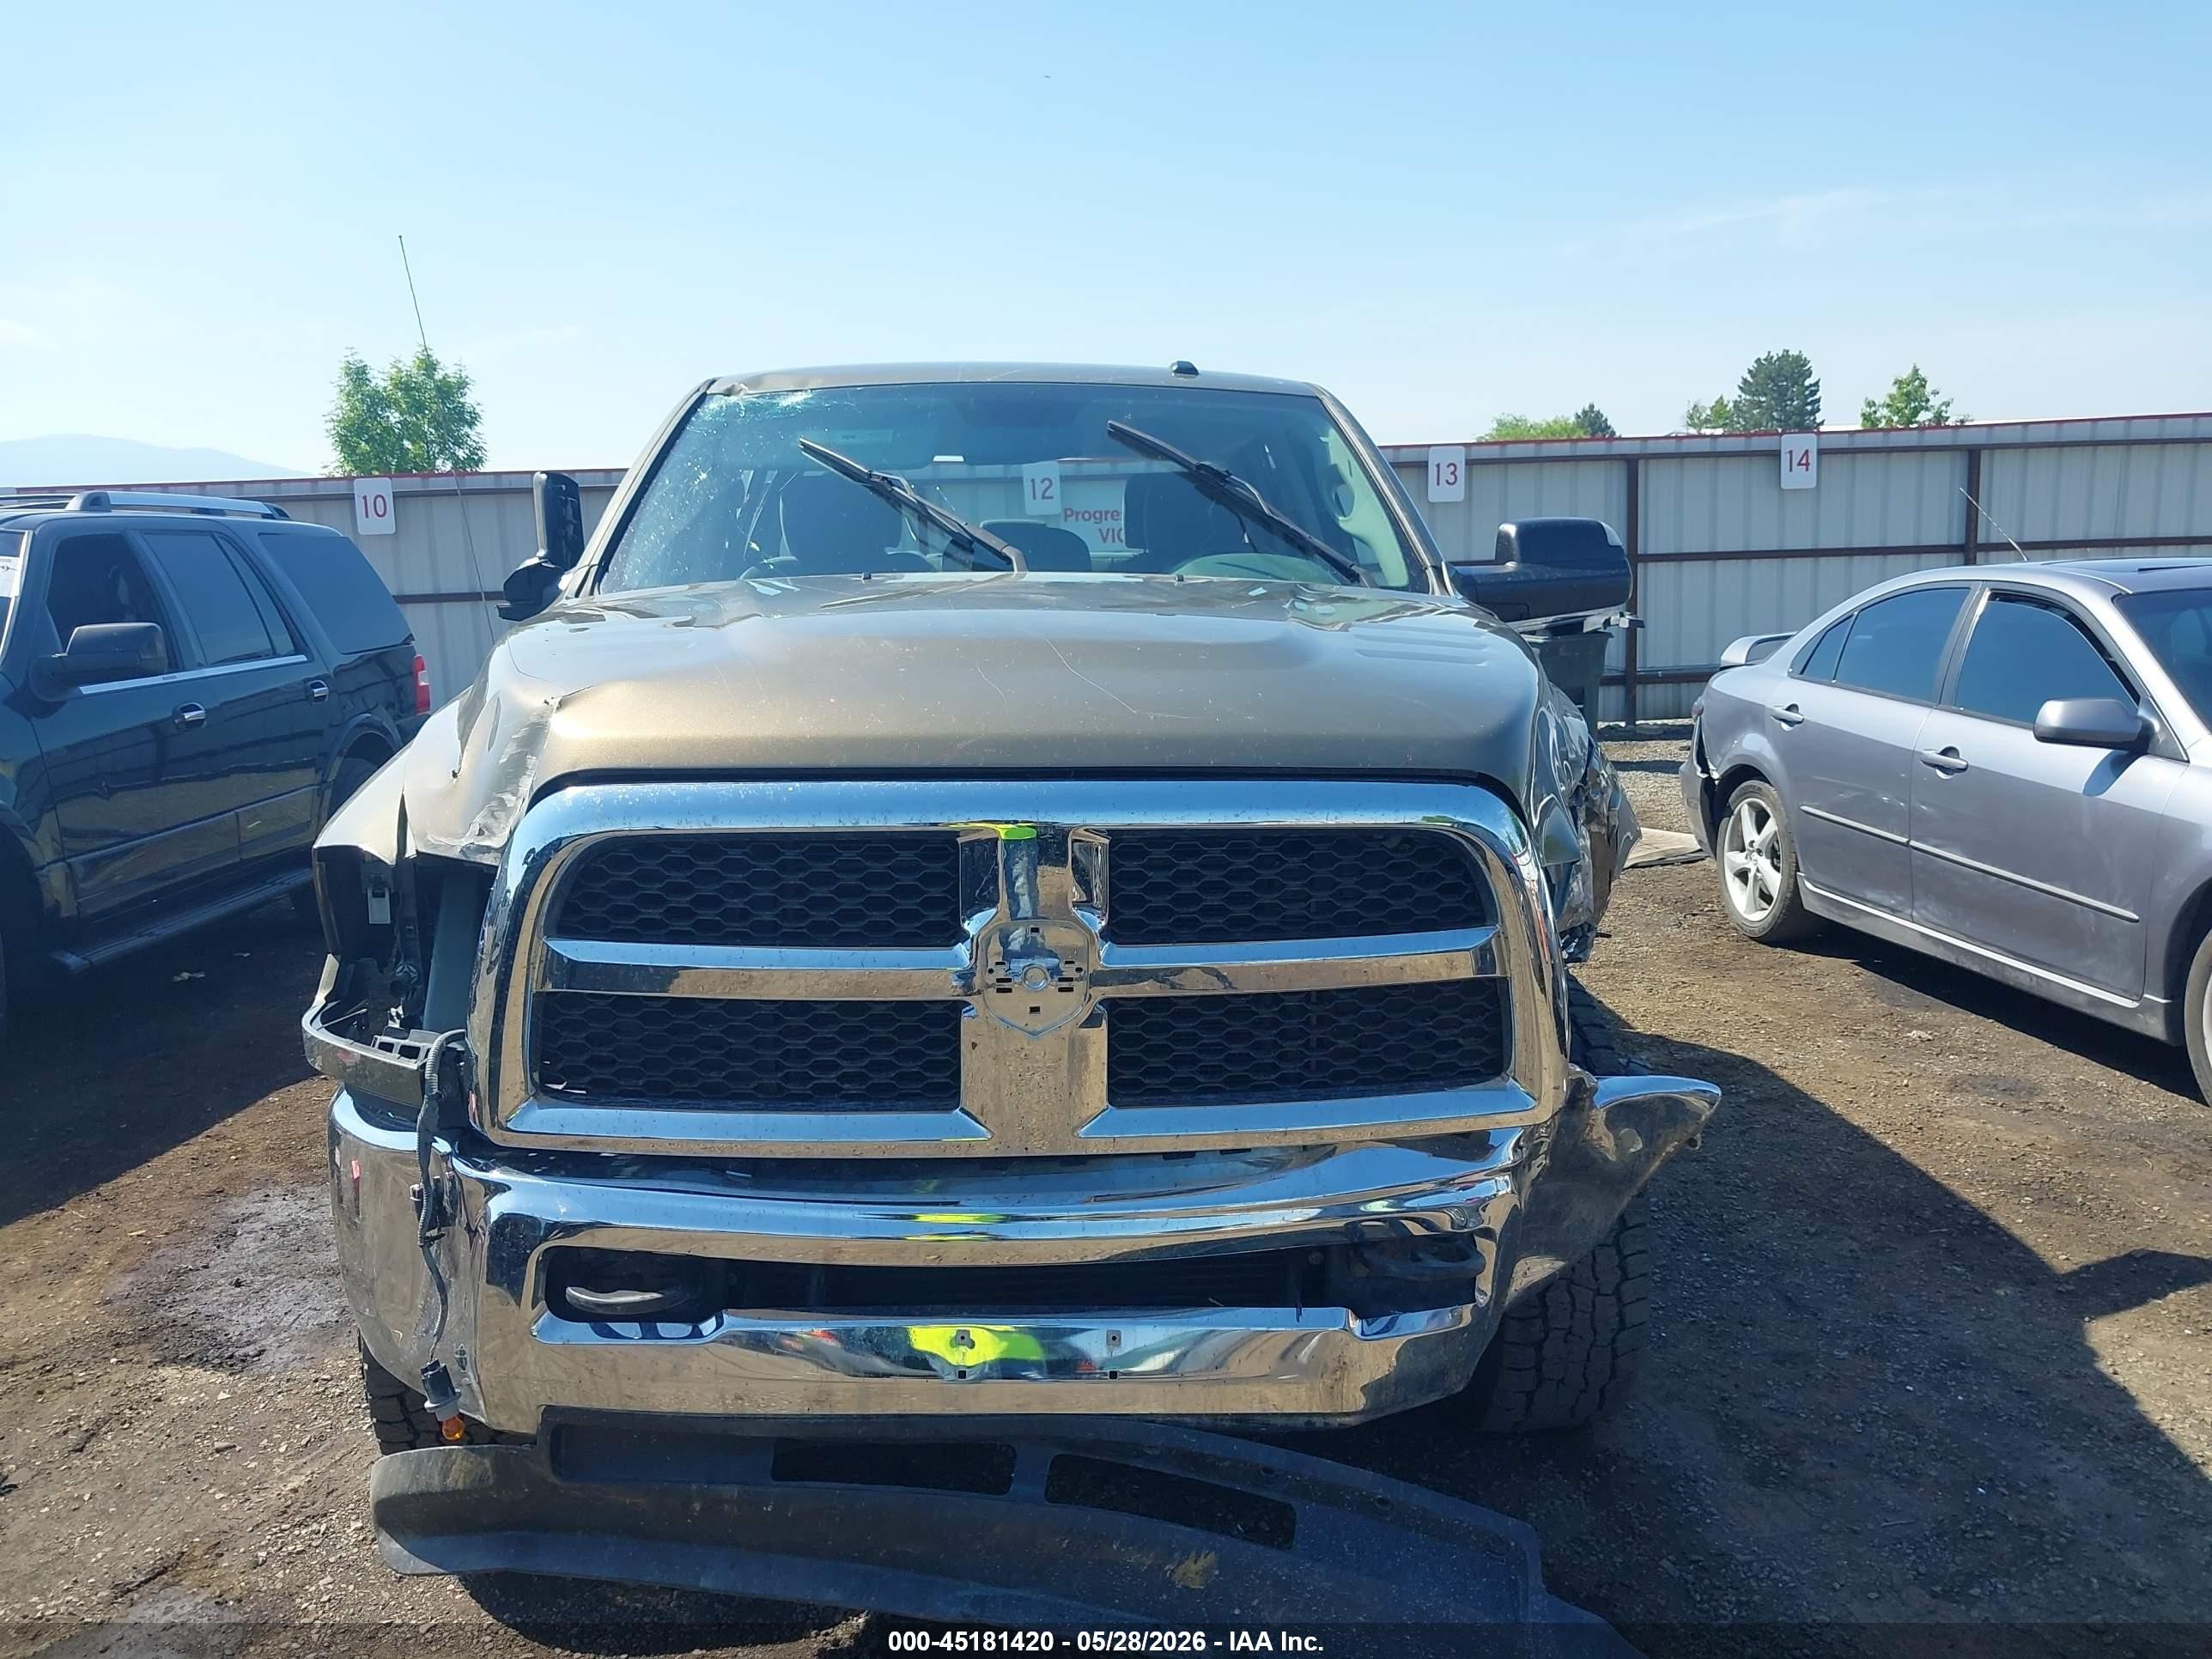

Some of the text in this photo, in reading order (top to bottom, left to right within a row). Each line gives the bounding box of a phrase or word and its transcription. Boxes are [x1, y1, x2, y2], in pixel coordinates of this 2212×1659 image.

[1786, 448, 1811, 473] 14
[1435, 462, 1458, 488] 13
[1030, 477, 1054, 501] 12
[362, 494, 388, 519] 10
[1063, 507, 1122, 525] Progre
